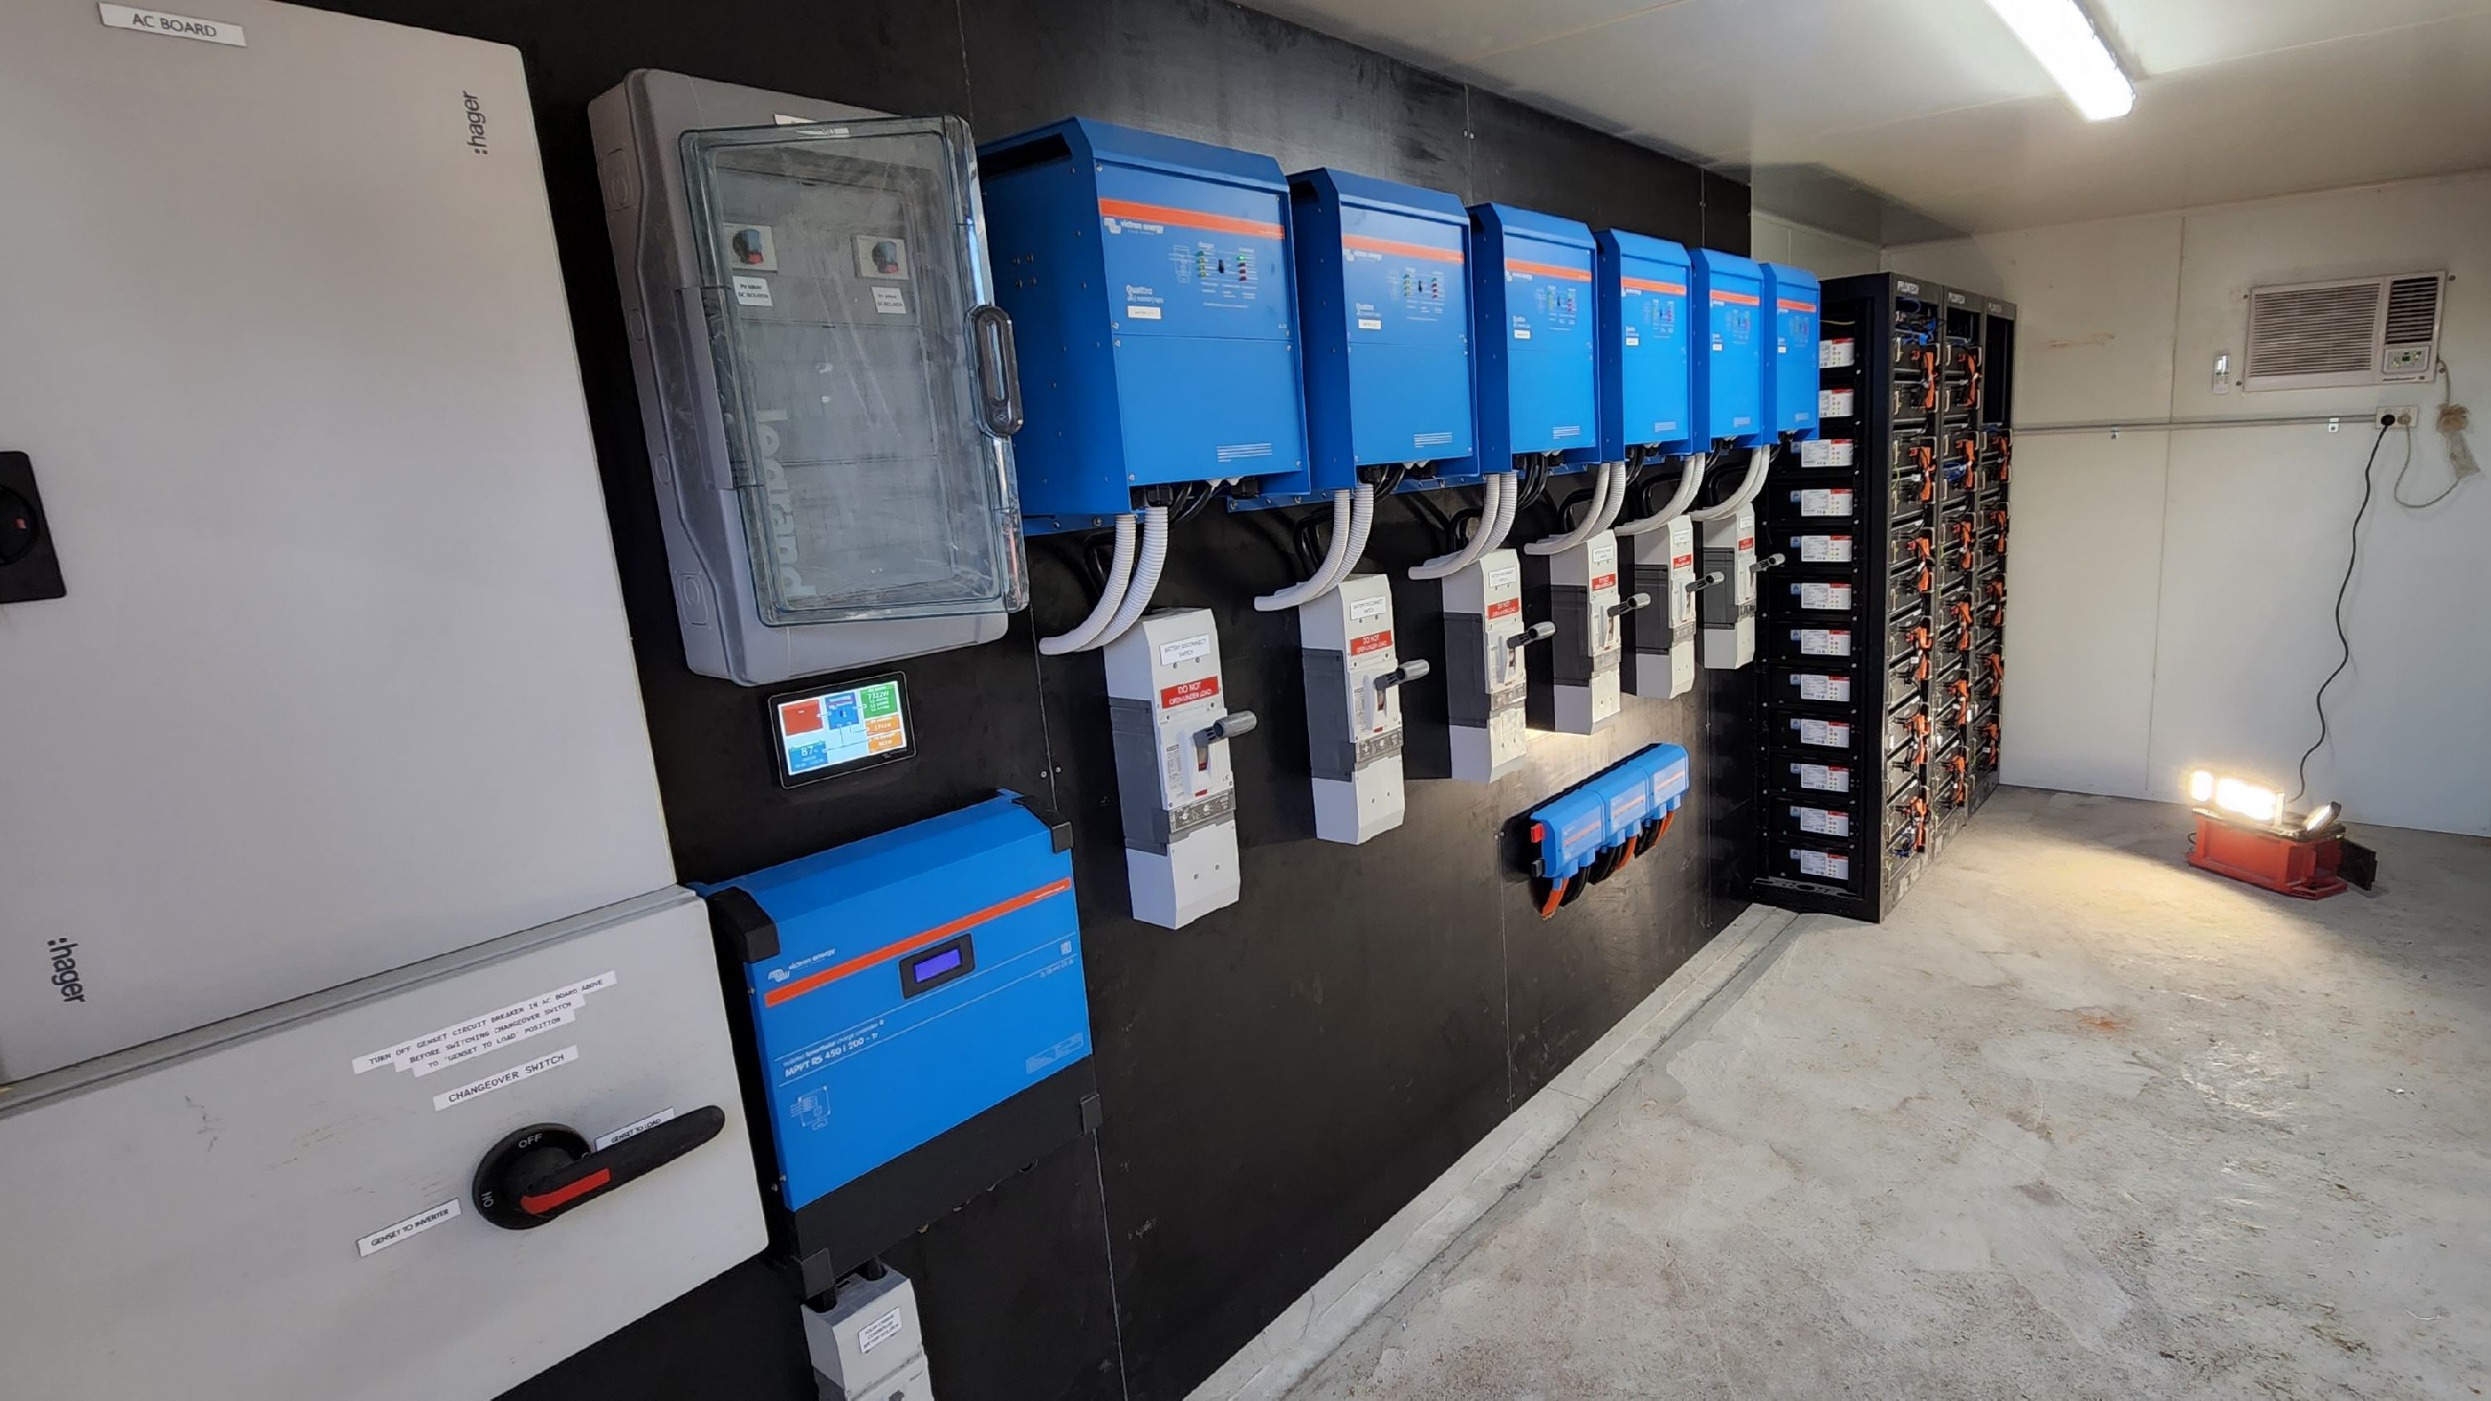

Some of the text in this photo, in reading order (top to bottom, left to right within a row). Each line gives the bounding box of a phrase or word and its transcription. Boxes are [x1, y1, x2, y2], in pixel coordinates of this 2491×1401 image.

[133, 13, 217, 38] AC BOARD
[1178, 681, 1202, 695] DO NOT
[801, 746, 813, 756] 87
[369, 1052, 392, 1065] TURN
[395, 1045, 412, 1056] OFF
[417, 1033, 448, 1048] GENSET
[452, 1020, 487, 1036] CIRCUIT
[491, 1007, 525, 1023] BREAKER
[528, 1001, 539, 1010] IN
[555, 988, 578, 1000] BOARD
[581, 979, 603, 992] ABOVE
[410, 1001, 572, 1063] BEFORE SWITCHING CHANGEOVER SWITCH
[428, 1060, 440, 1068] TO
[482, 1041, 493, 1049] TO
[525, 1016, 561, 1034] POSITION
[785, 1060, 810, 1077] MPPT
[811, 1056, 823, 1066] RS
[825, 1047, 842, 1059] 450
[848, 1037, 865, 1050] 200
[448, 1053, 565, 1103] CHANGEOVER SWITCH
[518, 1133, 543, 1149] OFF
[611, 1130, 634, 1143] GENSET
[481, 1191, 494, 1208] ON
[371, 1208, 449, 1247] GENSET TO INVERTER
